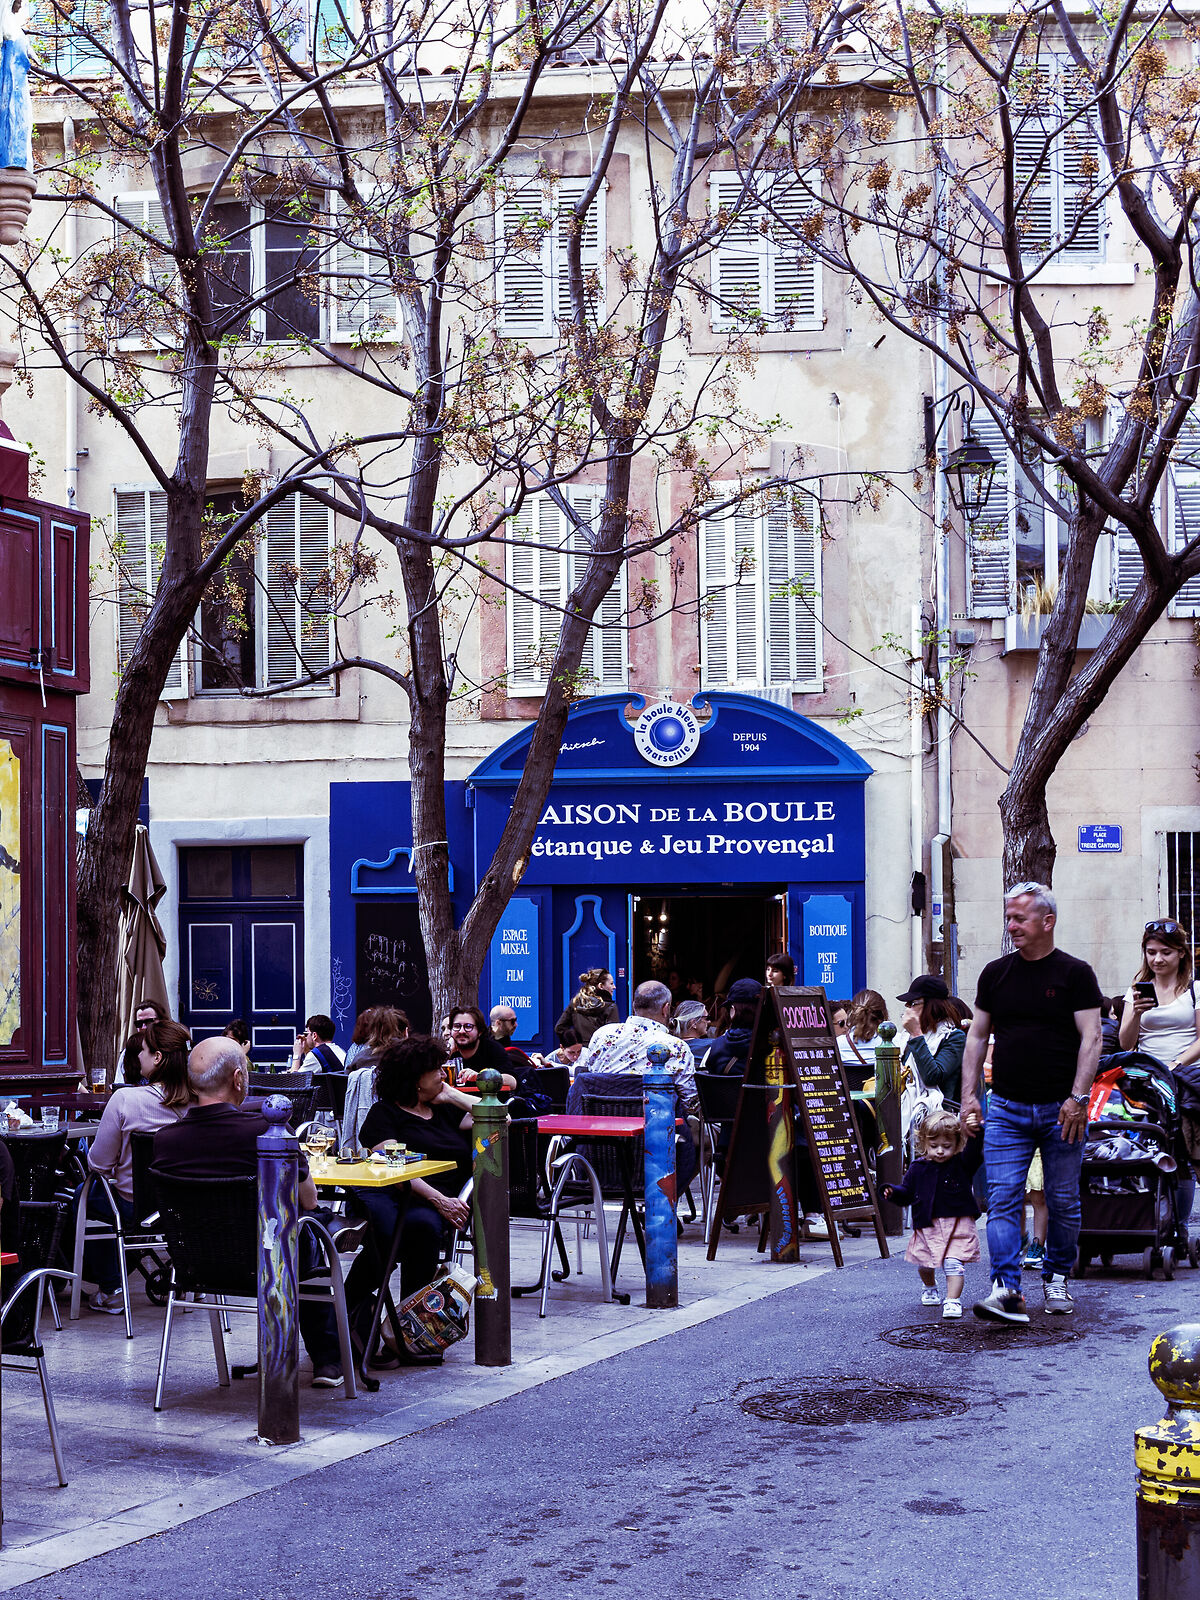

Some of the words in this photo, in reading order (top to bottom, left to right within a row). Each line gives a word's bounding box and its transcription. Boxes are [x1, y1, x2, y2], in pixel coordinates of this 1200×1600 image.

[645, 703, 673, 722] boule
[675, 706, 696, 734] bleue
[733, 733, 767, 741] DEPUIS
[644, 744, 691, 762] marseille
[537, 804, 641, 825] AISON
[650, 808, 680, 822] DE
[687, 808, 717, 822] LA
[723, 802, 836, 822] BOULE
[531, 837, 632, 860] étanque
[640, 839, 655, 854] &
[659, 835, 703, 854] Jeu
[706, 833, 835, 859] Provençal
[503, 929, 528, 941] ESPACE
[809, 924, 848, 937] BOUTIQUE
[500, 943, 530, 955] MUSEAL
[818, 952, 838, 964] PISTE
[506, 969, 524, 982] FILM
[821, 972, 835, 983] JEU
[499, 996, 532, 1008] HISTOIRE
